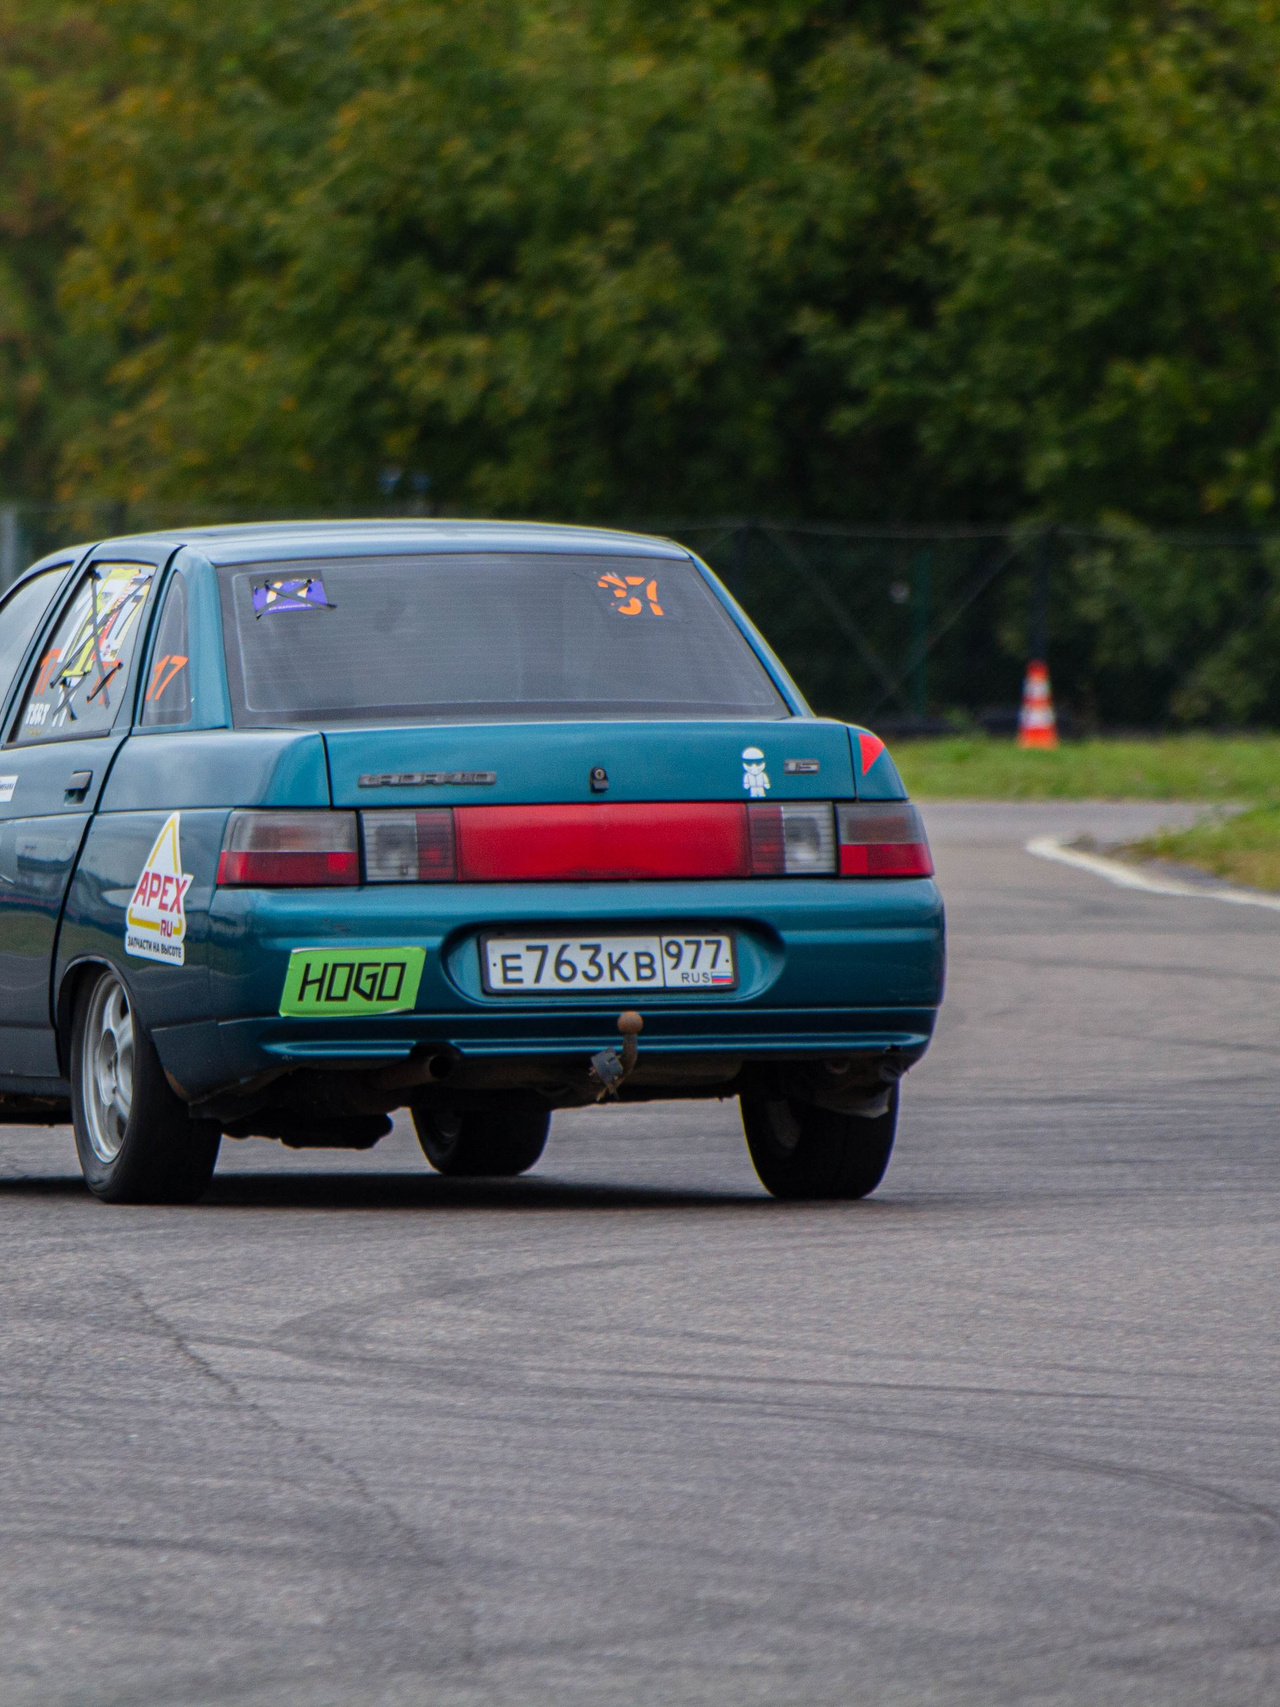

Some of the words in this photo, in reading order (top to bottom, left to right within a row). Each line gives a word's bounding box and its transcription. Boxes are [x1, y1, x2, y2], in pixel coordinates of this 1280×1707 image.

[145, 655, 189, 701] 17
[132, 871, 188, 915] APEX
[160, 919, 173, 938] RU
[297, 962, 407, 1002] HOGO
[501, 943, 657, 985] E763KB
[665, 939, 723, 970] 977
[681, 972, 711, 984] RUS
